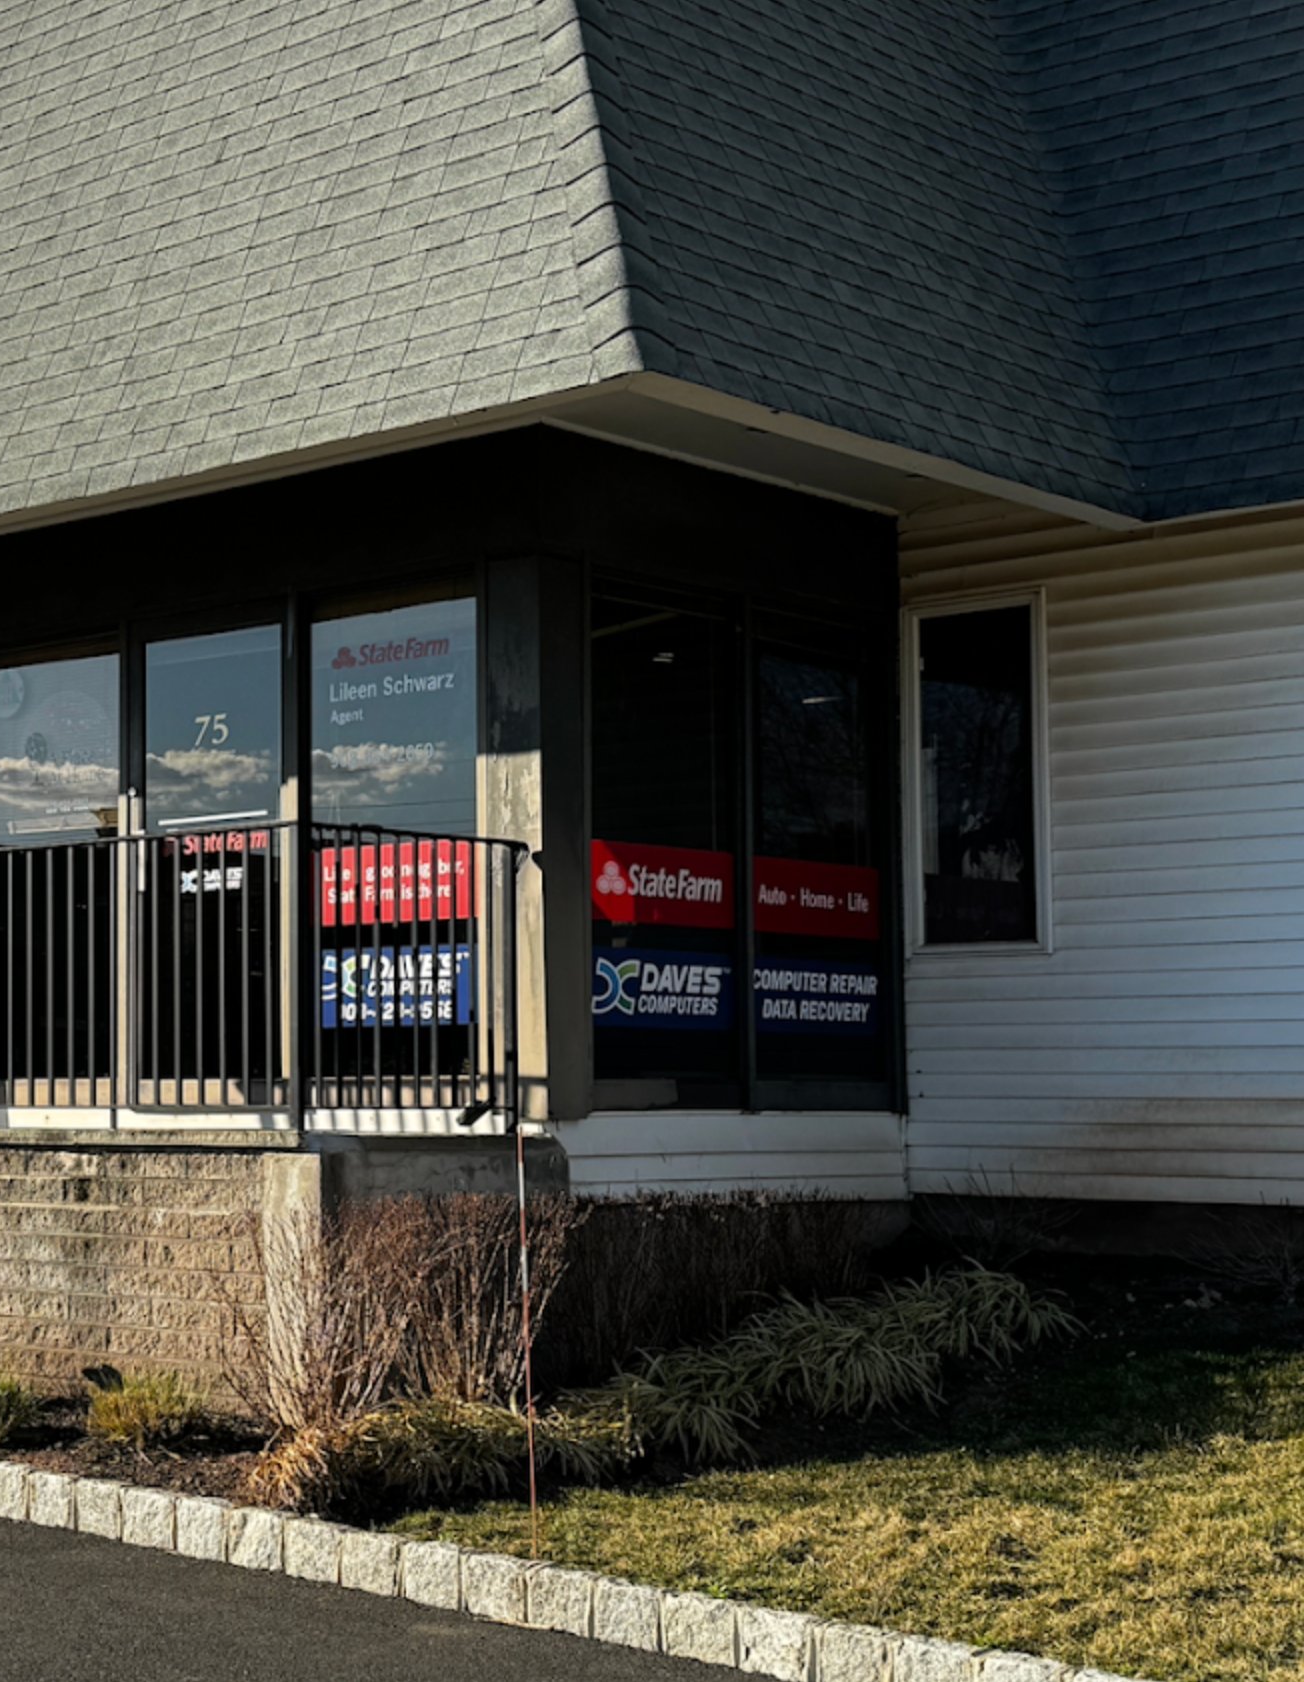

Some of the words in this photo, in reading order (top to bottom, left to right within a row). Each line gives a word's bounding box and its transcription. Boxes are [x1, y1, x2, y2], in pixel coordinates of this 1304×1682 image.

[382, 673, 455, 697] Schwarz
[194, 713, 229, 746] 75
[329, 709, 364, 726] Agent
[323, 865, 353, 882] Lie
[627, 863, 723, 903] StateFarm
[757, 884, 788, 906] Auto
[799, 887, 836, 910] Home
[847, 893, 870, 913] Life
[640, 962, 724, 995] DAVES
[753, 968, 827, 994] COMPUTER
[829, 973, 879, 996] REPAIR
[637, 994, 720, 1016] COMPUTERS
[762, 998, 797, 1020] DATA
[799, 1000, 870, 1023] RECOVERY
